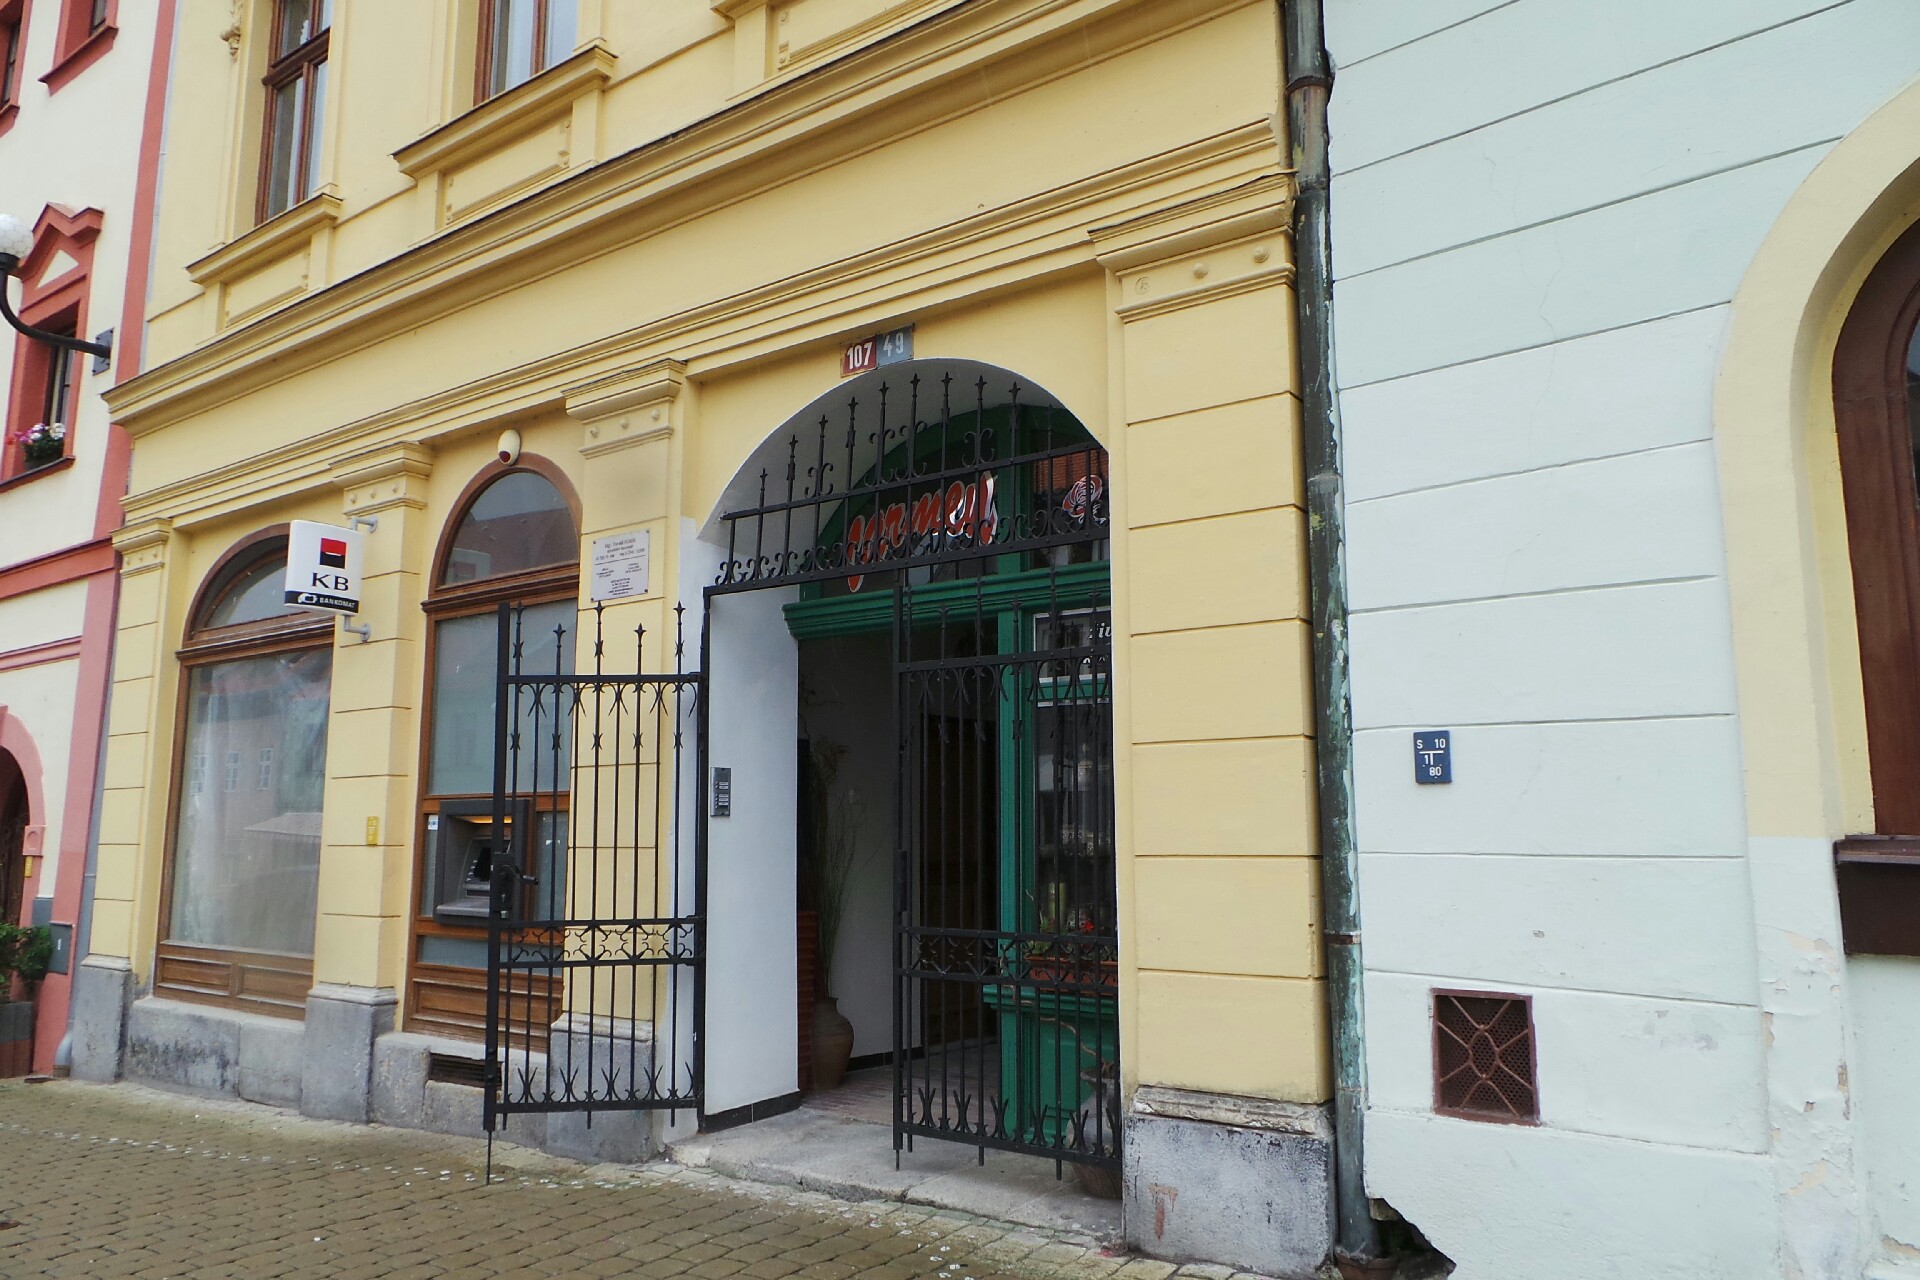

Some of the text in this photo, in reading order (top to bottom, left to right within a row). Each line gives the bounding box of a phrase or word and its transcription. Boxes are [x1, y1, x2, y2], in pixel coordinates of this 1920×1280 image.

[883, 332, 904, 358] 49
[846, 341, 873, 370] 107
[311, 572, 349, 592] KB
[319, 597, 356, 609] BANKOMAT
[1416, 738, 1446, 749] S 10
[1424, 754, 1429, 765] 1
[1429, 766, 1442, 777] 80
